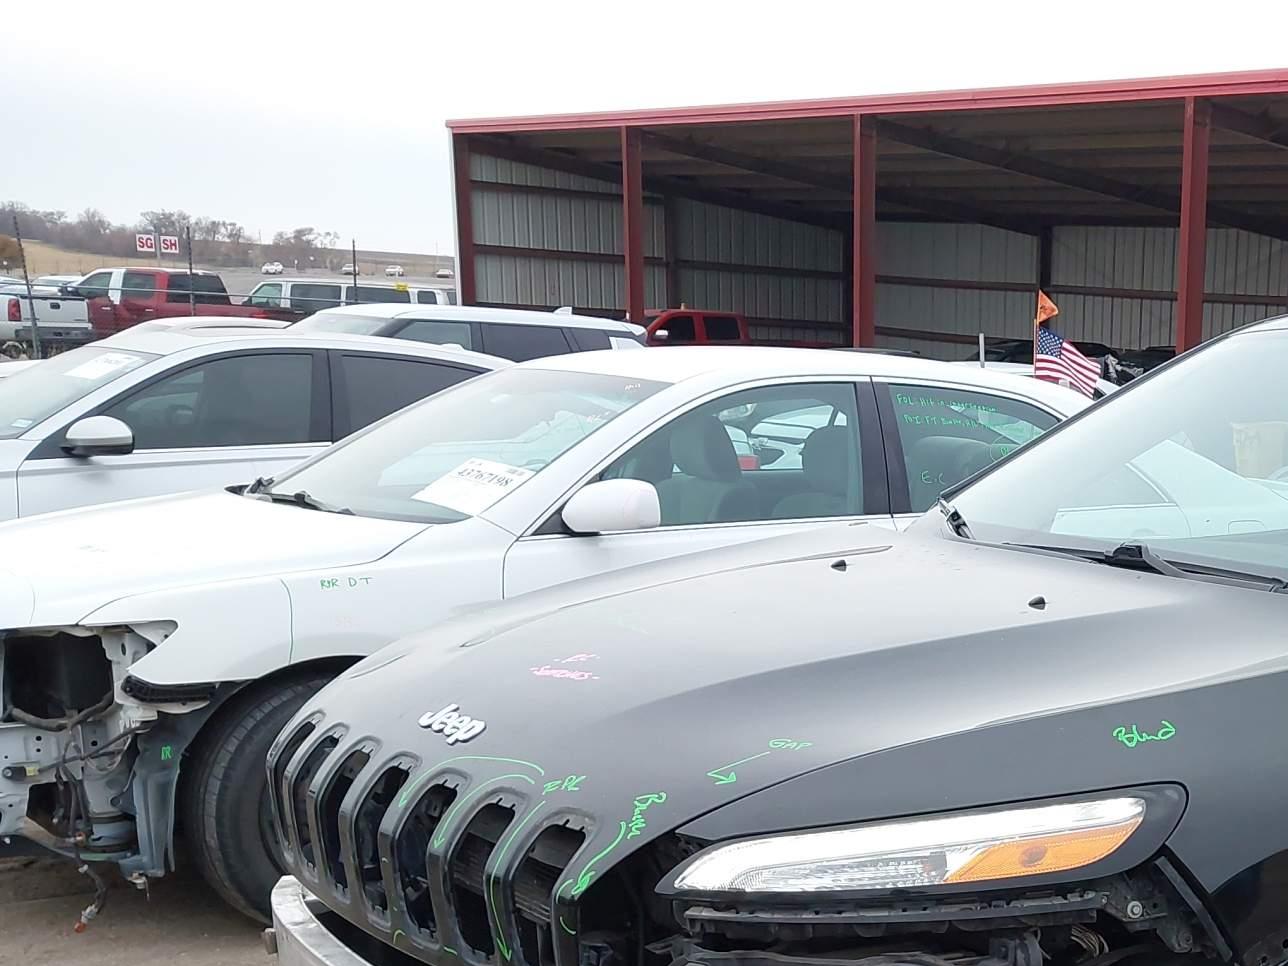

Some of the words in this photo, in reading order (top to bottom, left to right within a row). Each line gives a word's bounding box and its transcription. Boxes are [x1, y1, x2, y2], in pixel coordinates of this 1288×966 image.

[137, 236, 154, 249] SG
[162, 238, 178, 251] SH
[418, 703, 486, 745] Jeep
